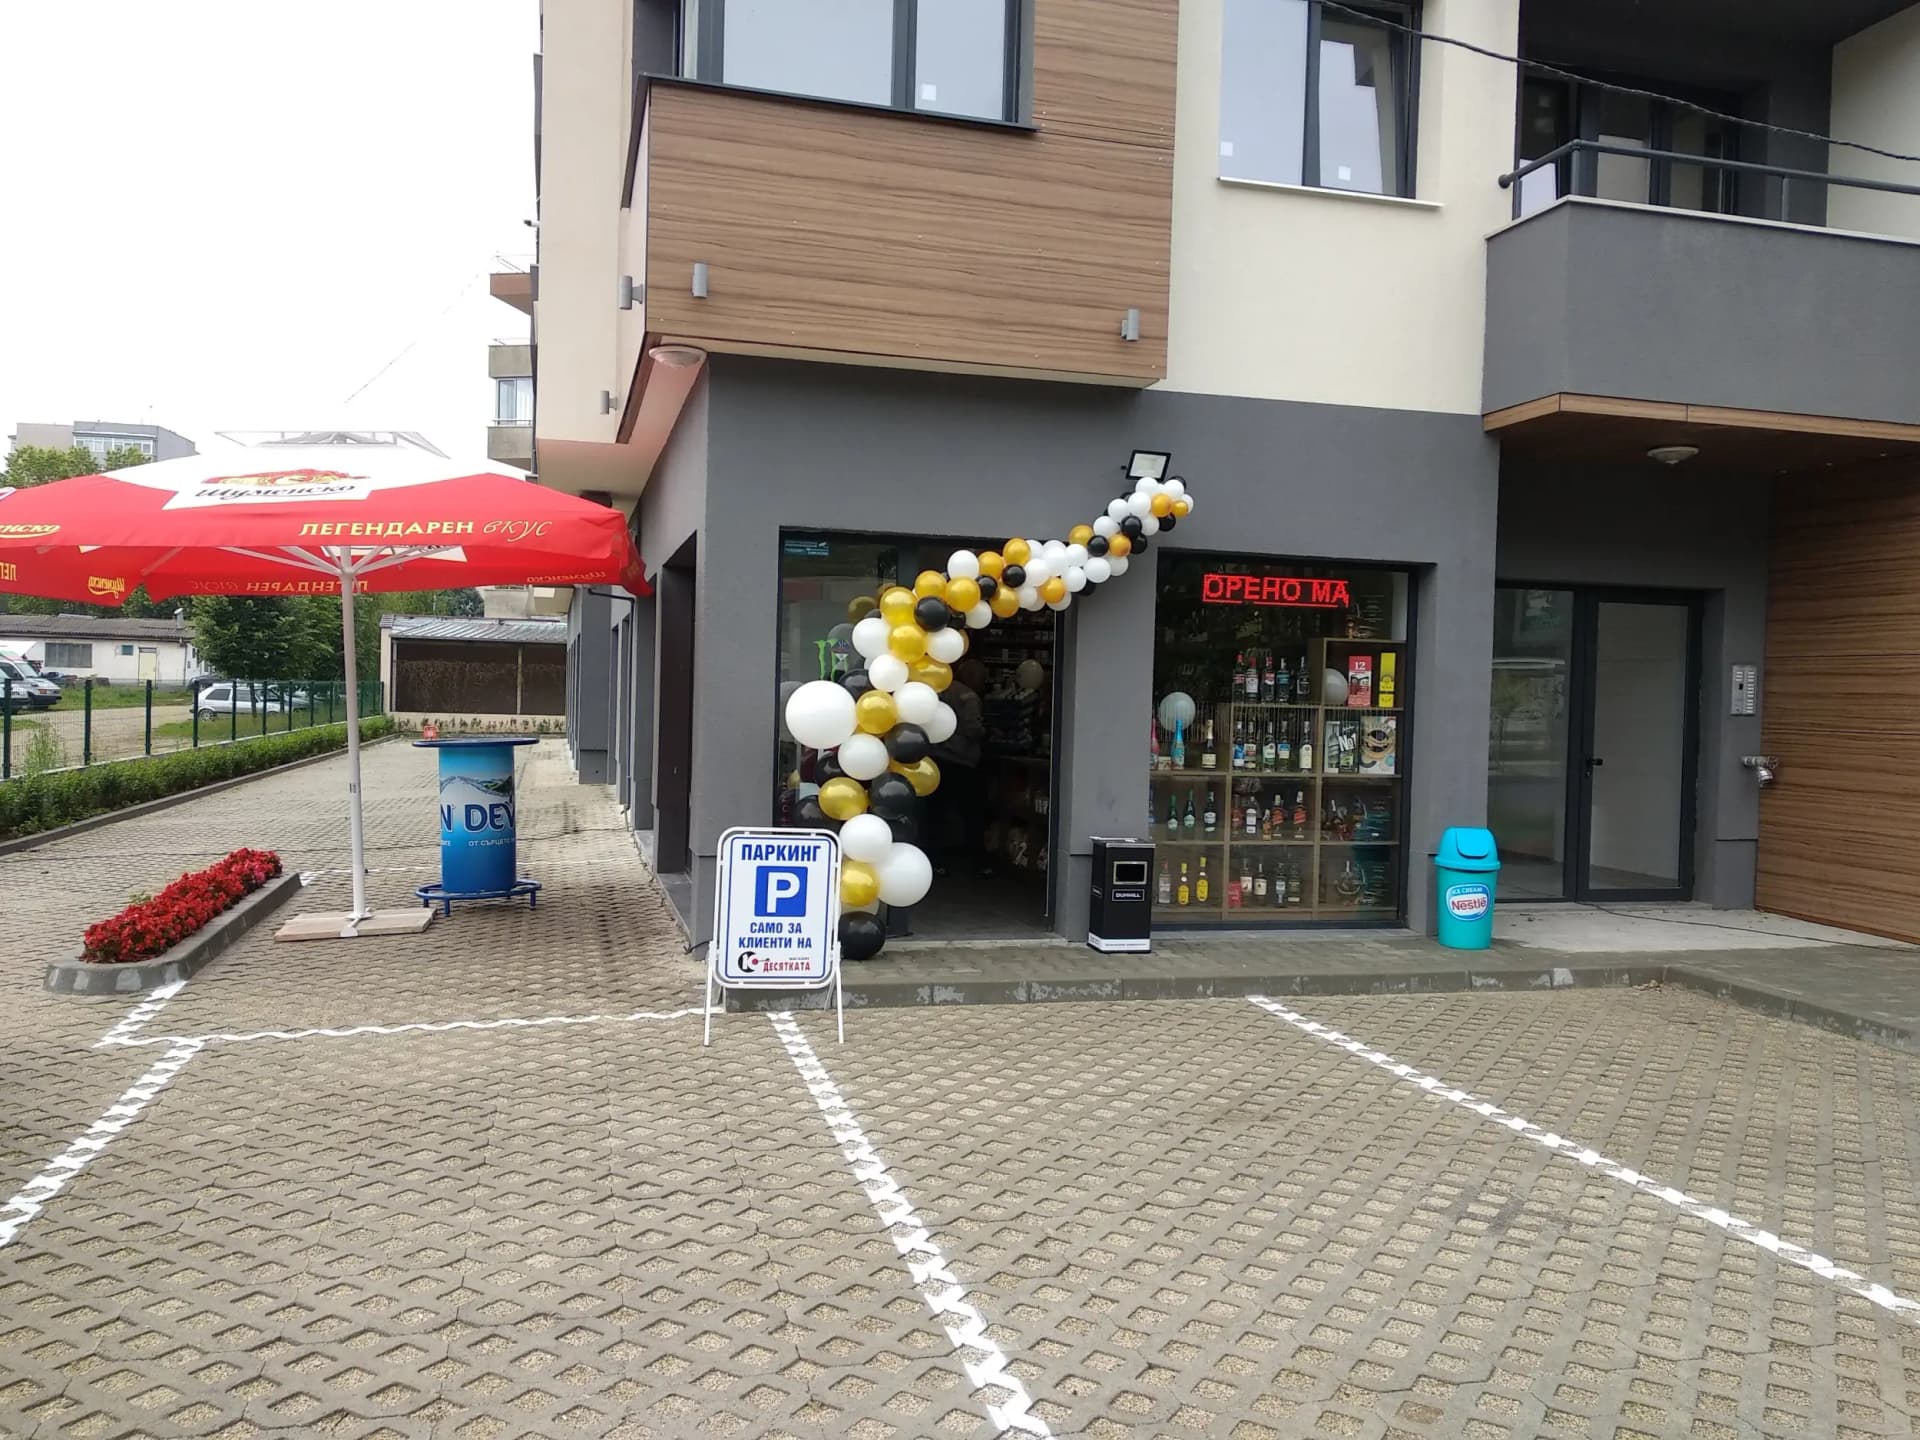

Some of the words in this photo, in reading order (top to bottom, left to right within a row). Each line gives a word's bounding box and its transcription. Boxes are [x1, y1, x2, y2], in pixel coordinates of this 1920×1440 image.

[298, 521, 474, 537] ЛЕГЕНДАРЕН
[483, 520, 552, 542] вкус
[741, 844, 821, 862] ПАРКИНГ
[766, 871, 801, 914] P
[750, 922, 783, 934] САМО
[788, 922, 802, 934] ЗА
[738, 937, 792, 949] КЛИЕНТИ
[797, 937, 812, 949] НА
[763, 961, 811, 973] ДЕСЯТКАТА
